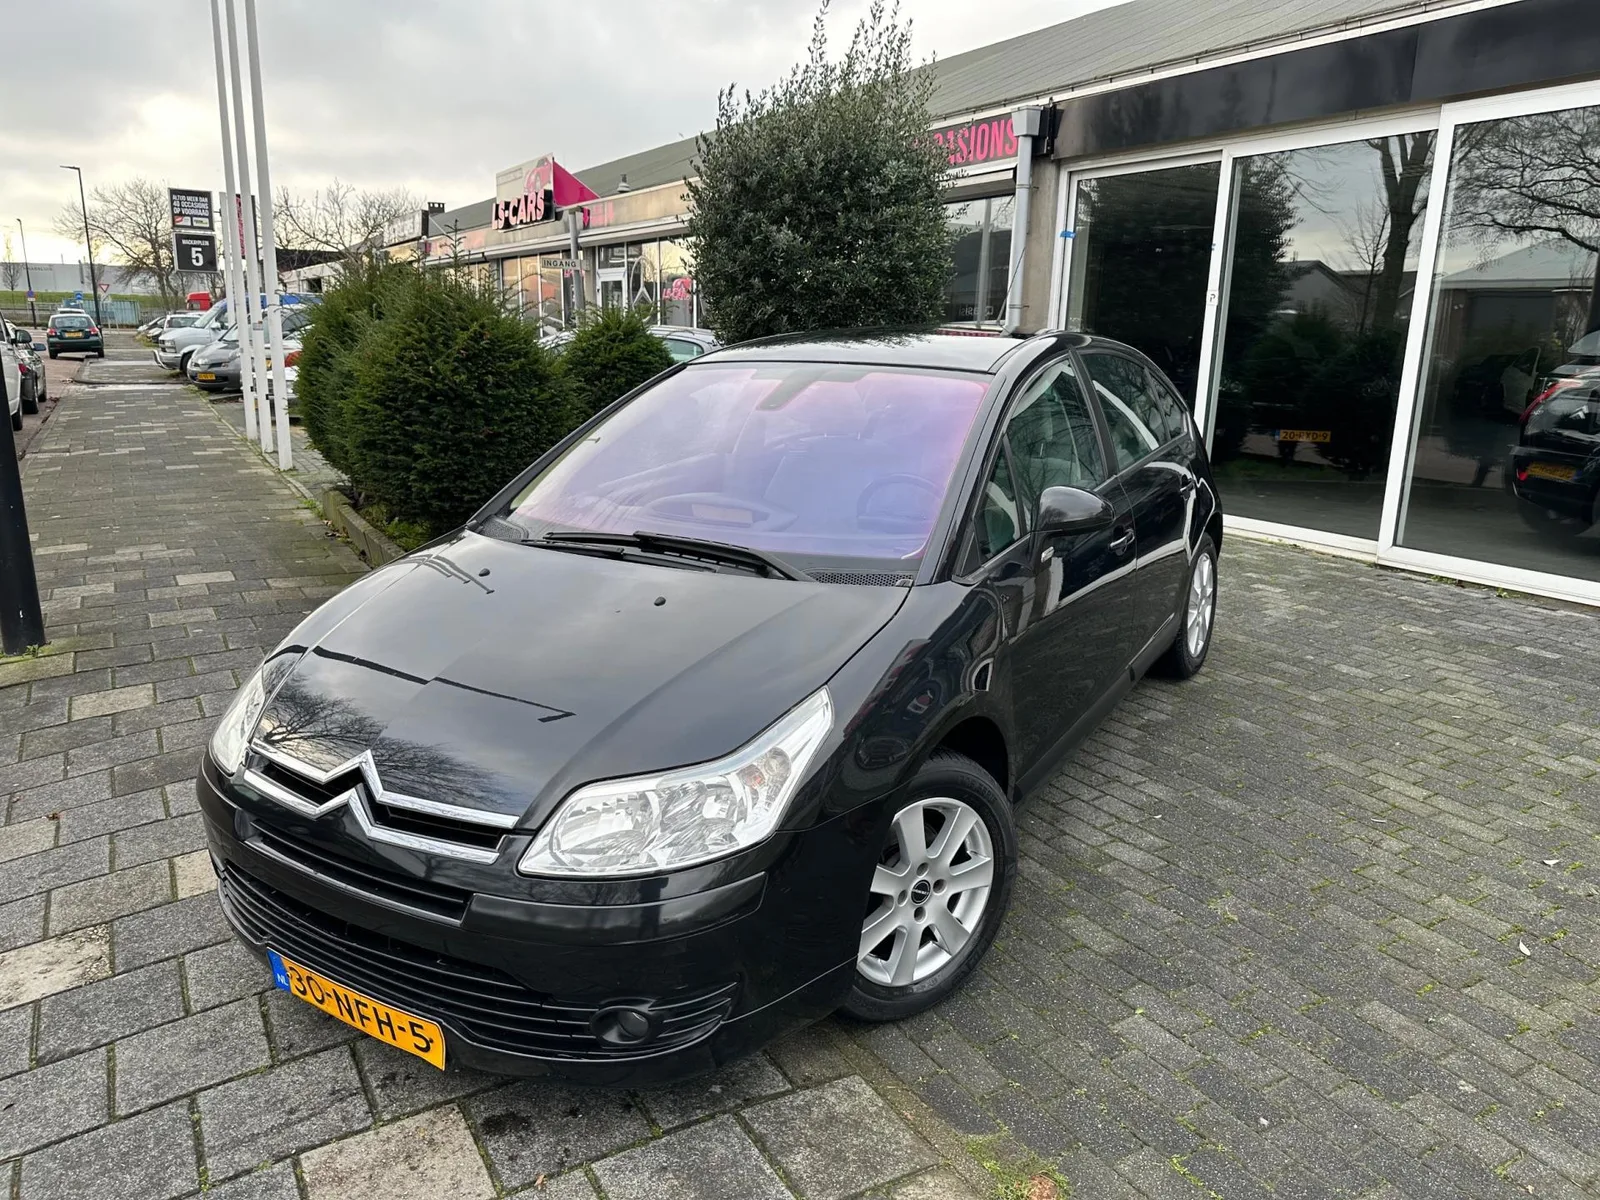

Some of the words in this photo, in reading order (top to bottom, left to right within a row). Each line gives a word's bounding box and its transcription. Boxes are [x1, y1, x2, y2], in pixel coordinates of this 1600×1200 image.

[492, 189, 545, 230] LS-CARS
[191, 247, 204, 267] 5
[543, 259, 577, 268] INGANG
[277, 973, 289, 987] NL
[288, 966, 432, 1053] 30-NFH-5
